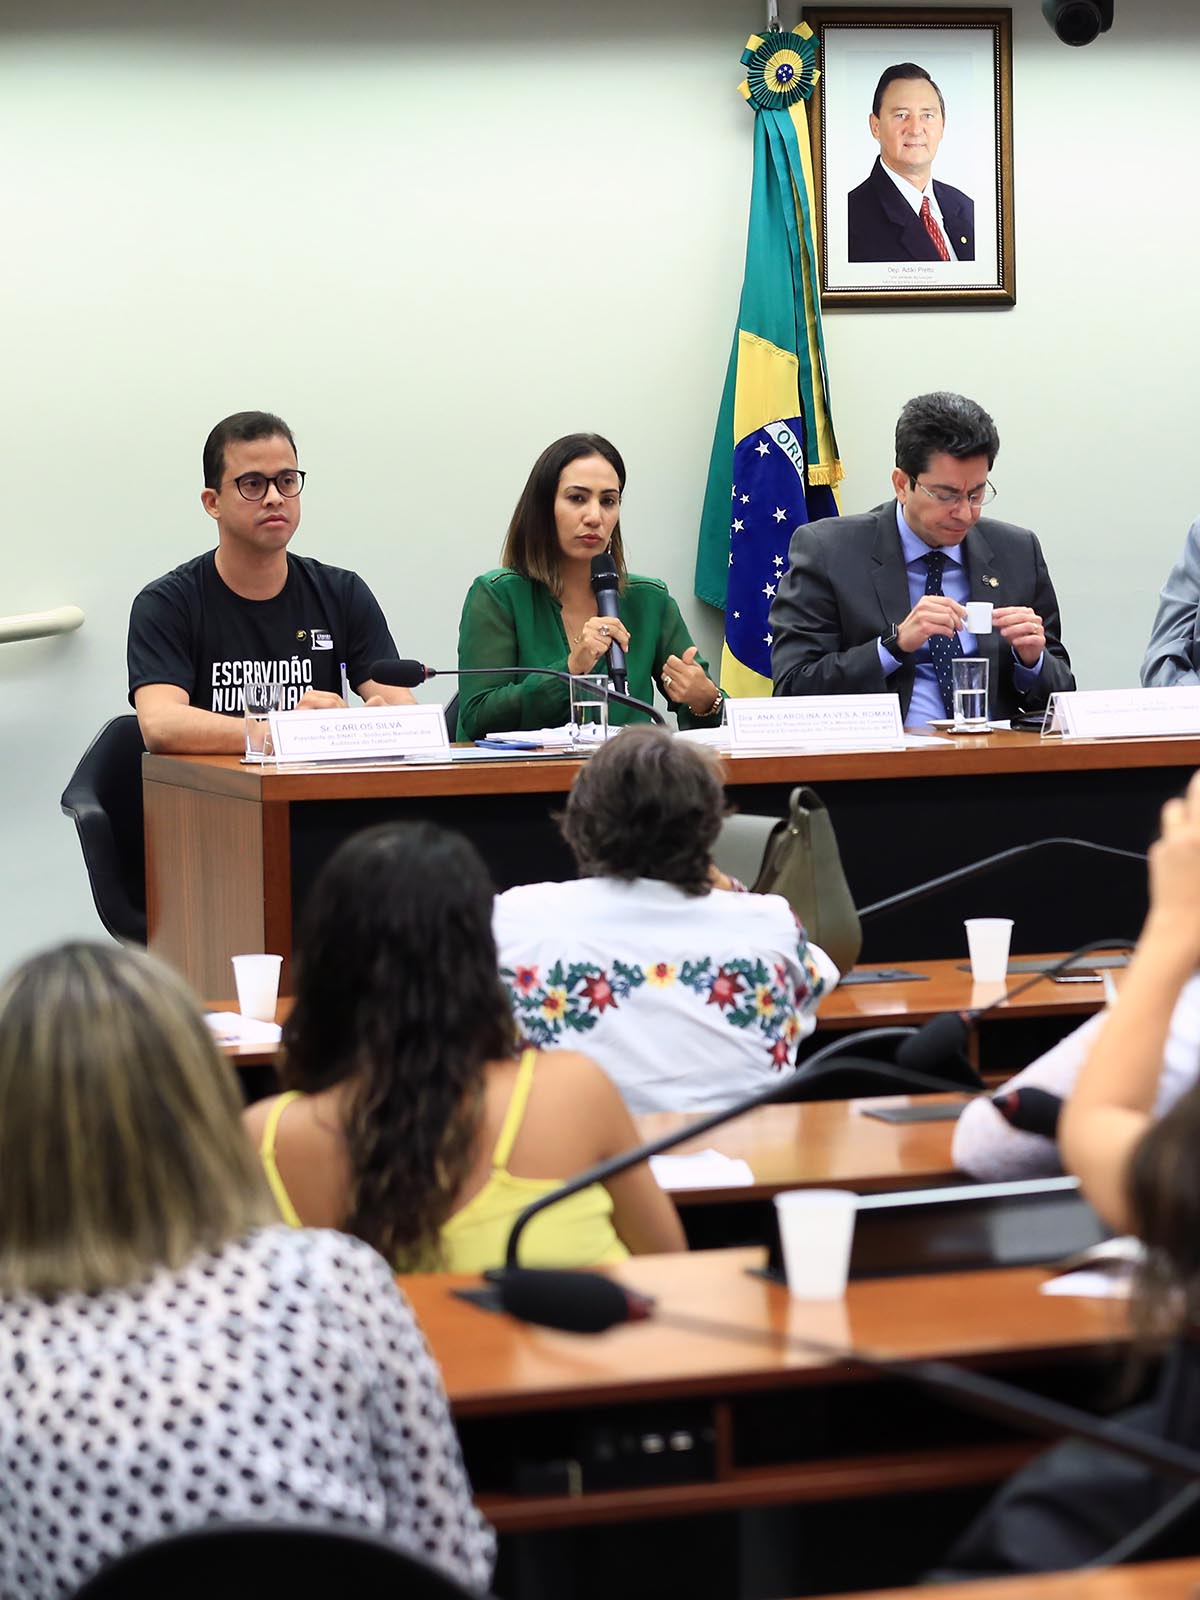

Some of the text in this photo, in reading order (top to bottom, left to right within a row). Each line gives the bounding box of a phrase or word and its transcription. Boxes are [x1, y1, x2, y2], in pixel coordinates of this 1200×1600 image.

[211, 656, 313, 686] ESCRAVIDÃO
[757, 713, 775, 721] ANA
[777, 711, 820, 720] CAROLINA
[335, 722, 373, 732] CARLOS
[375, 721, 402, 731] SILVA
